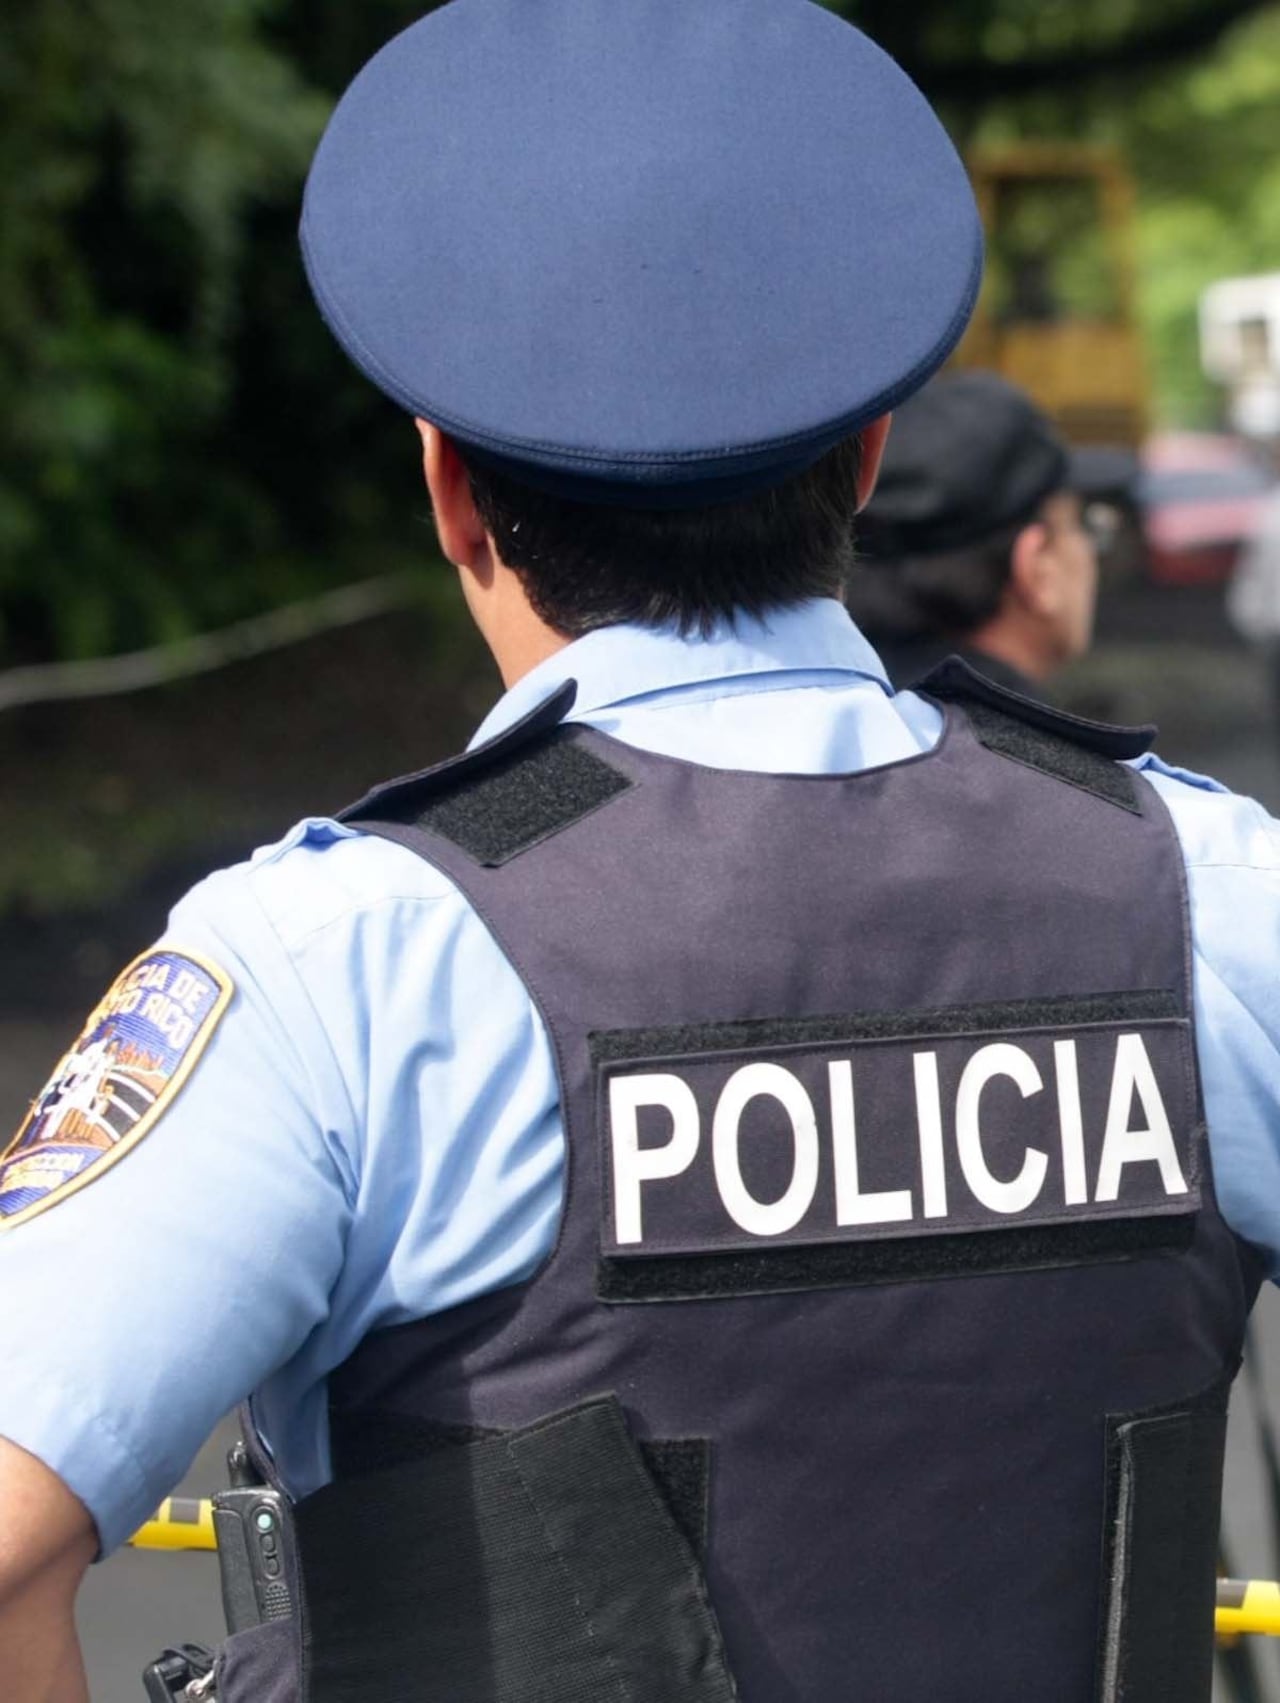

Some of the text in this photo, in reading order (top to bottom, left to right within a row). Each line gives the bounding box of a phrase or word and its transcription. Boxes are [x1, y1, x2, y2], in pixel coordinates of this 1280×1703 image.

[140, 991, 194, 1049] RICO
[167, 967, 210, 1015] DE
[608, 1033, 1189, 1244] POLICIA
